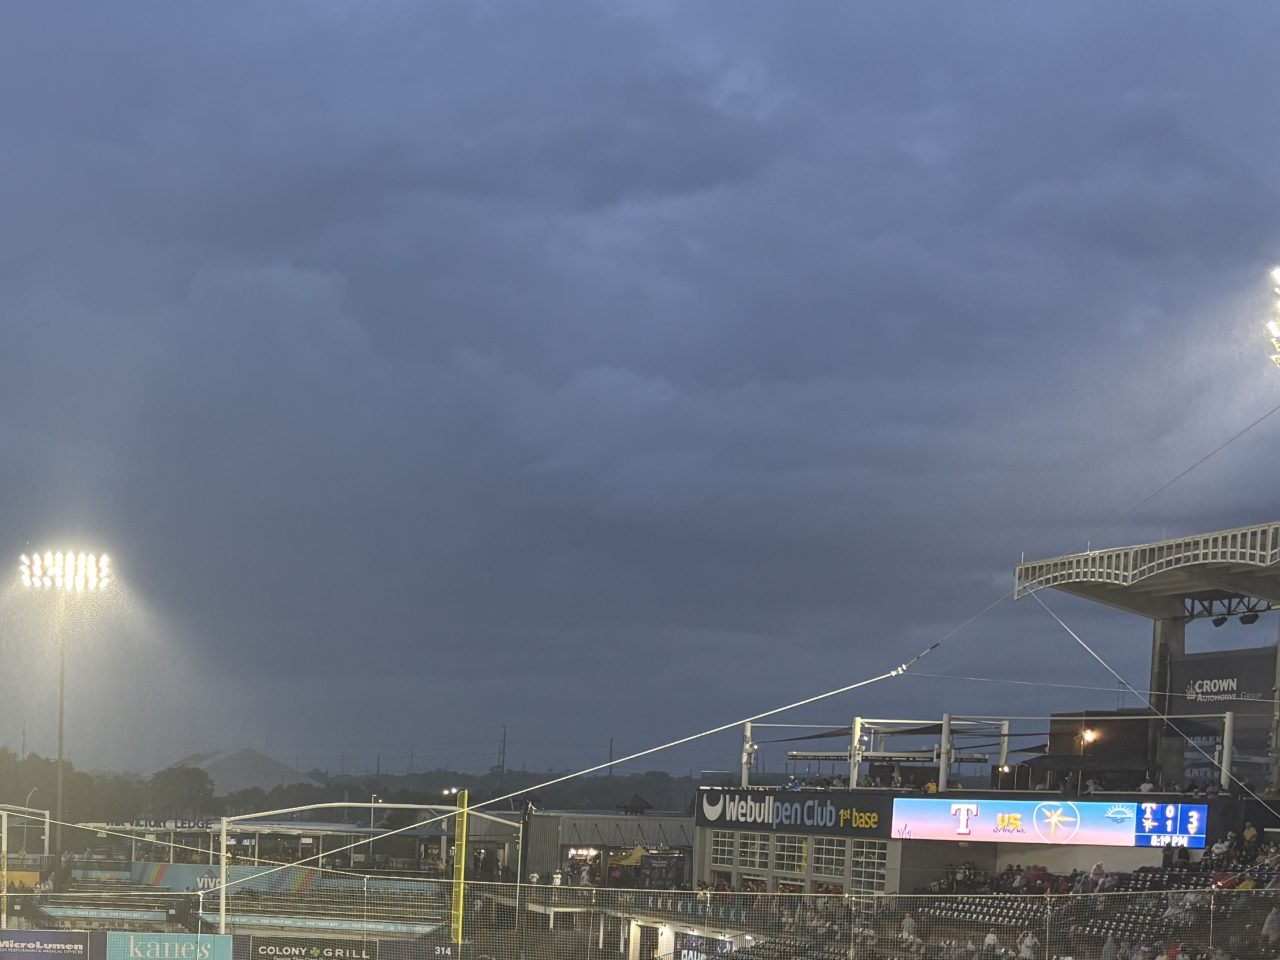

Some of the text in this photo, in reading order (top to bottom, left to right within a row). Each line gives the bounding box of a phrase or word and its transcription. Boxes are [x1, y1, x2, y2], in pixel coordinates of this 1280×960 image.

[1194, 678, 1238, 692] CROWN
[725, 794, 879, 829] Webullpen Club 1st base
[1166, 805, 1174, 818] 0
[174, 820, 213, 829] LEDGE
[950, 803, 979, 835] T
[1166, 820, 1173, 832] 1
[1172, 835, 1188, 847] PM
[258, 946, 370, 959] COLONY GRILL
[434, 946, 451, 955] 314
